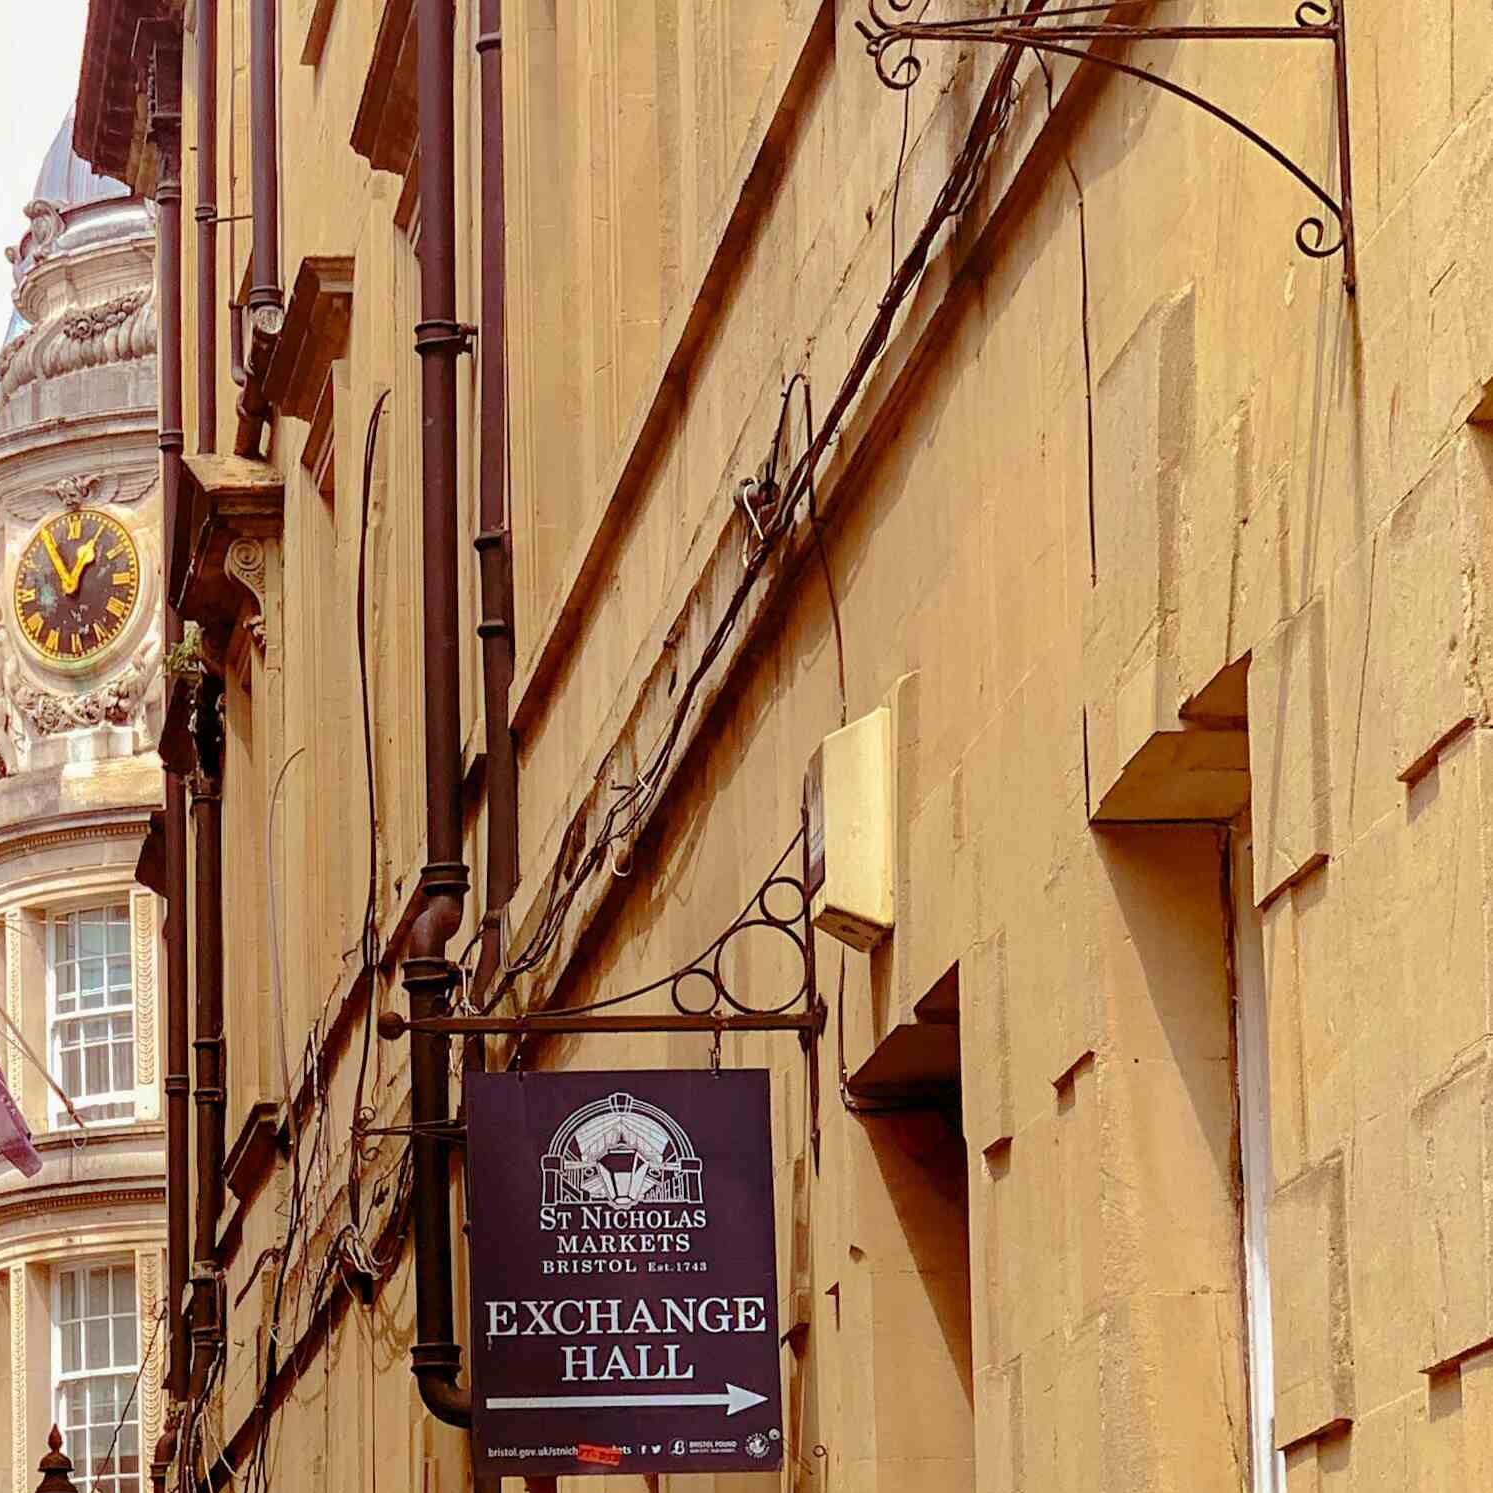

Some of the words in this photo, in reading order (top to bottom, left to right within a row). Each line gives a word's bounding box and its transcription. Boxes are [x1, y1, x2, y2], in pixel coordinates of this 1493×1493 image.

[557, 1233, 691, 1253] MARKETS
[542, 1259, 637, 1274] BRISTOL
[485, 1296, 767, 1337] EXCHANGE
[560, 1344, 694, 1382] HALL
